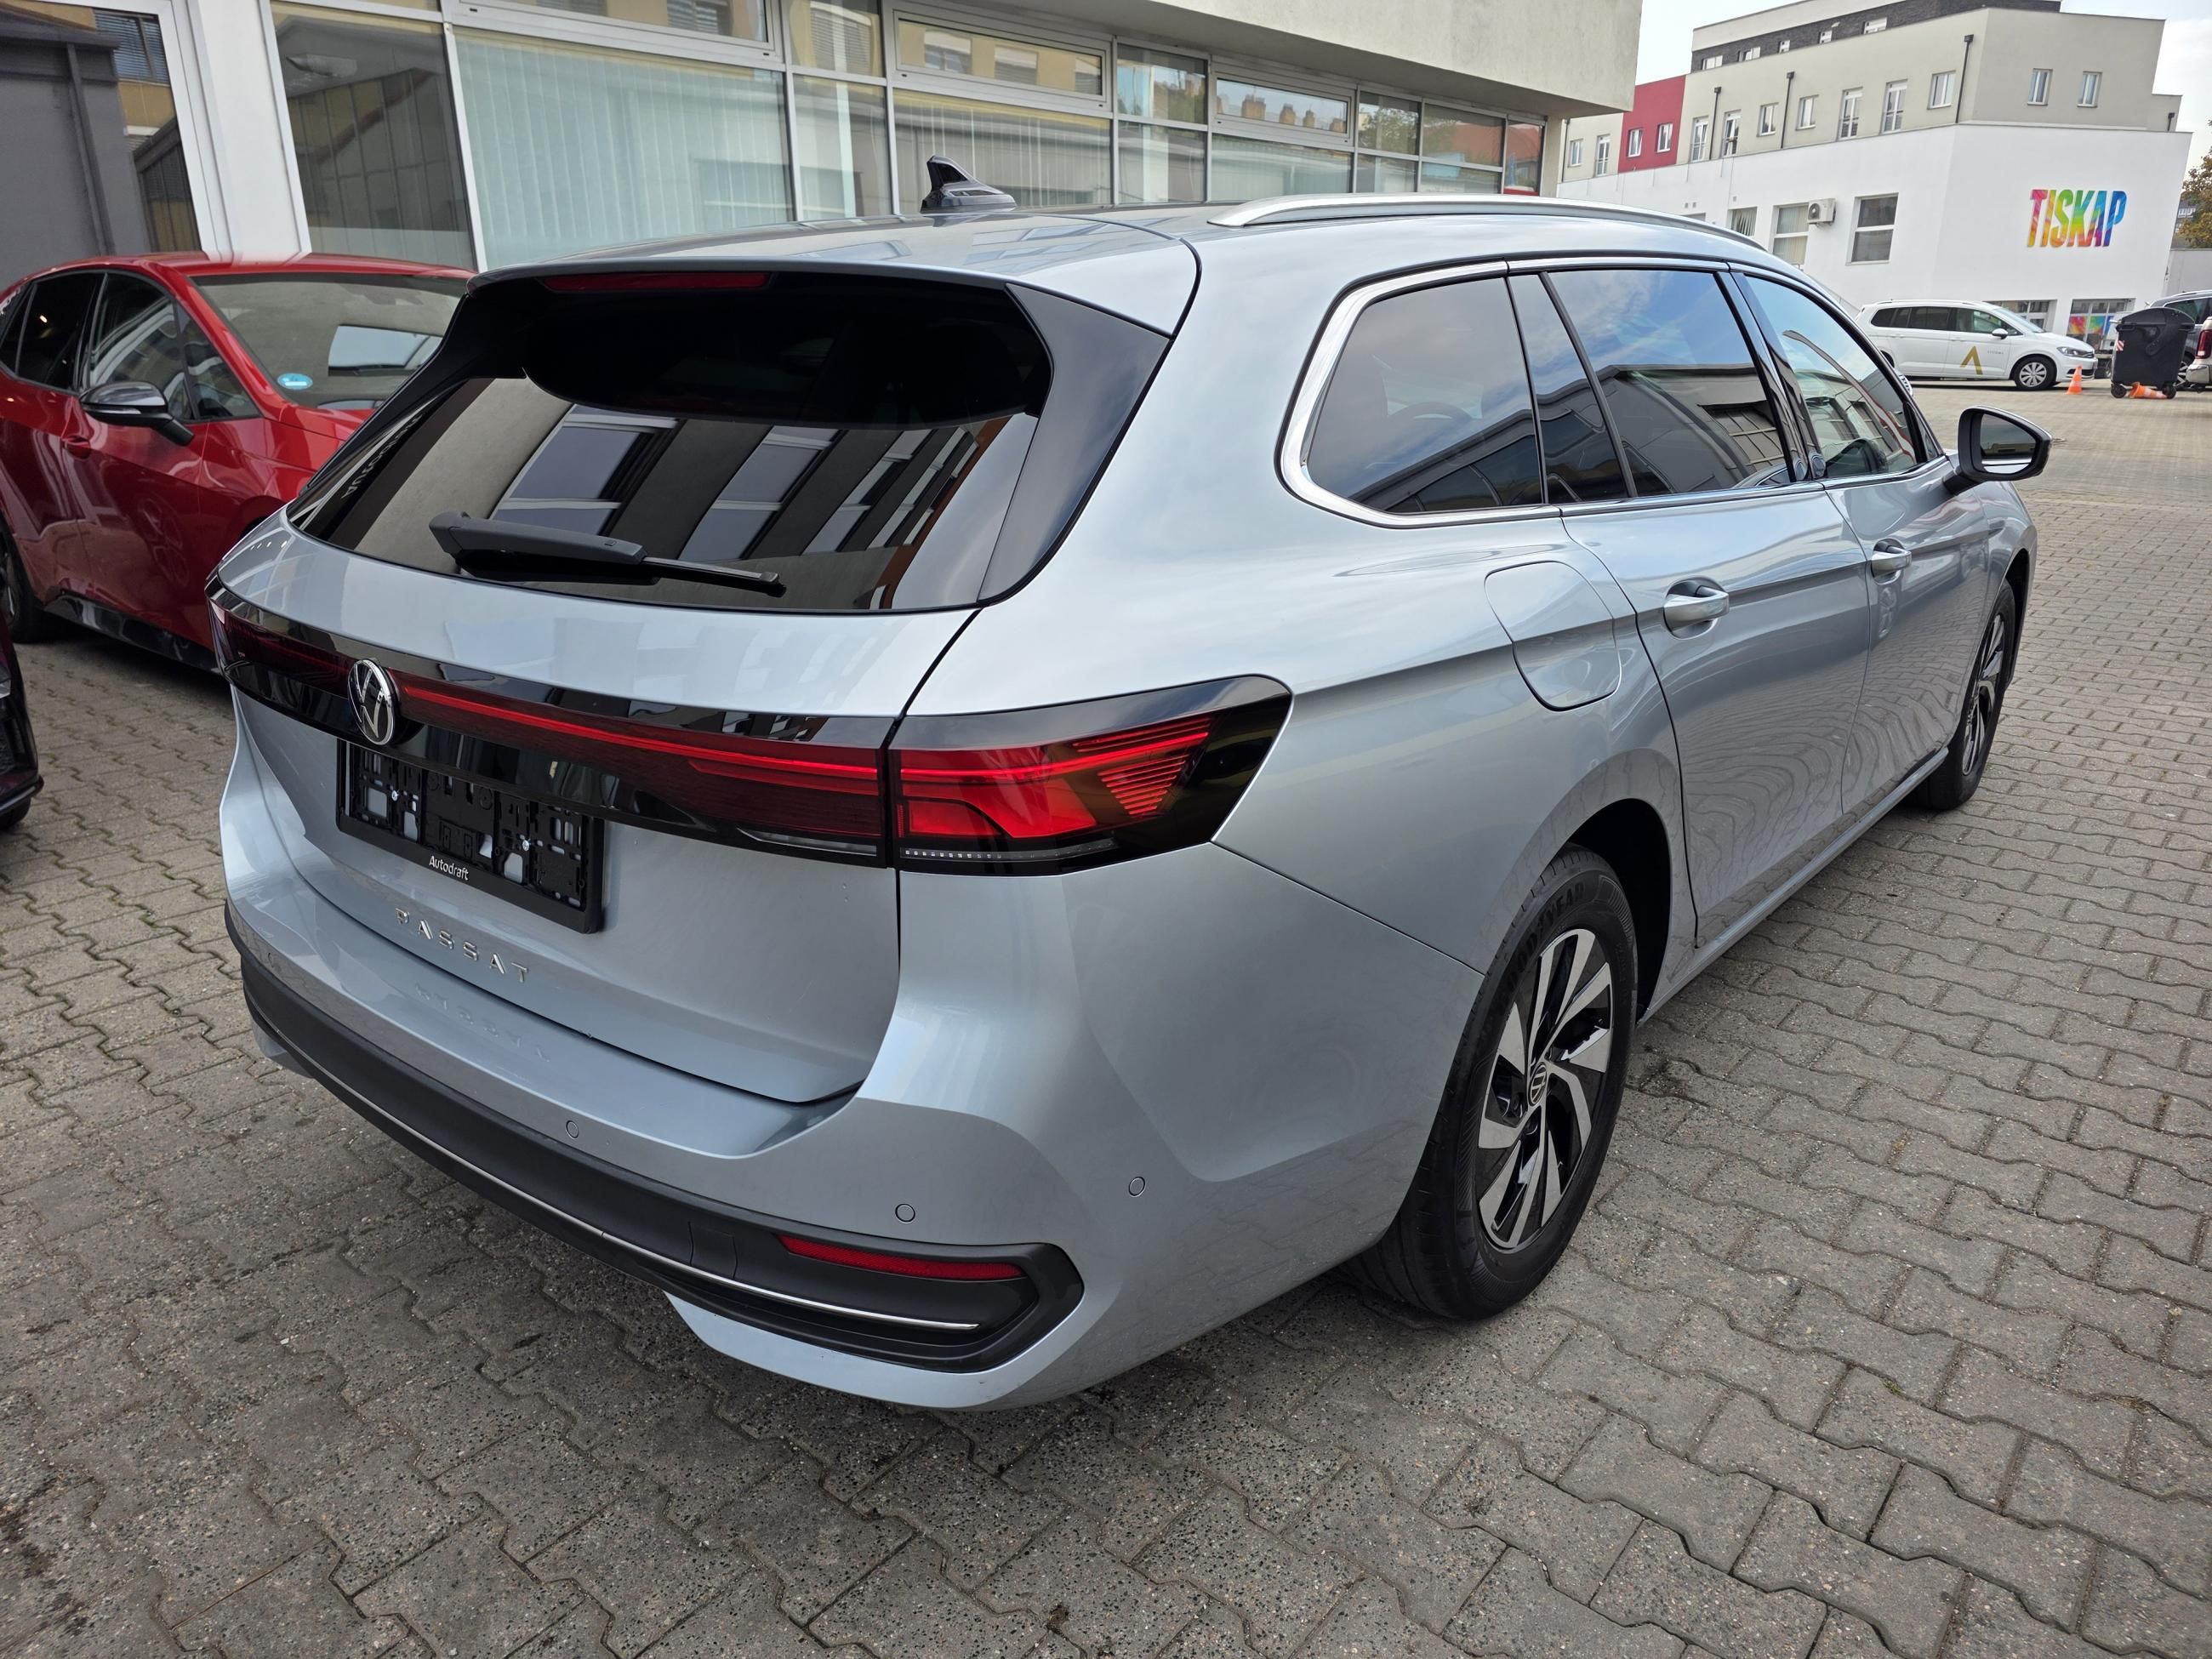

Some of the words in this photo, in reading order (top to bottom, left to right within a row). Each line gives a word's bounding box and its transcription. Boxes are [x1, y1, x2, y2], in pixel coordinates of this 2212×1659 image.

[2027, 189, 2128, 248] TISKAP
[428, 855, 469, 881] Autodraft
[395, 907, 528, 983] PASSAT
